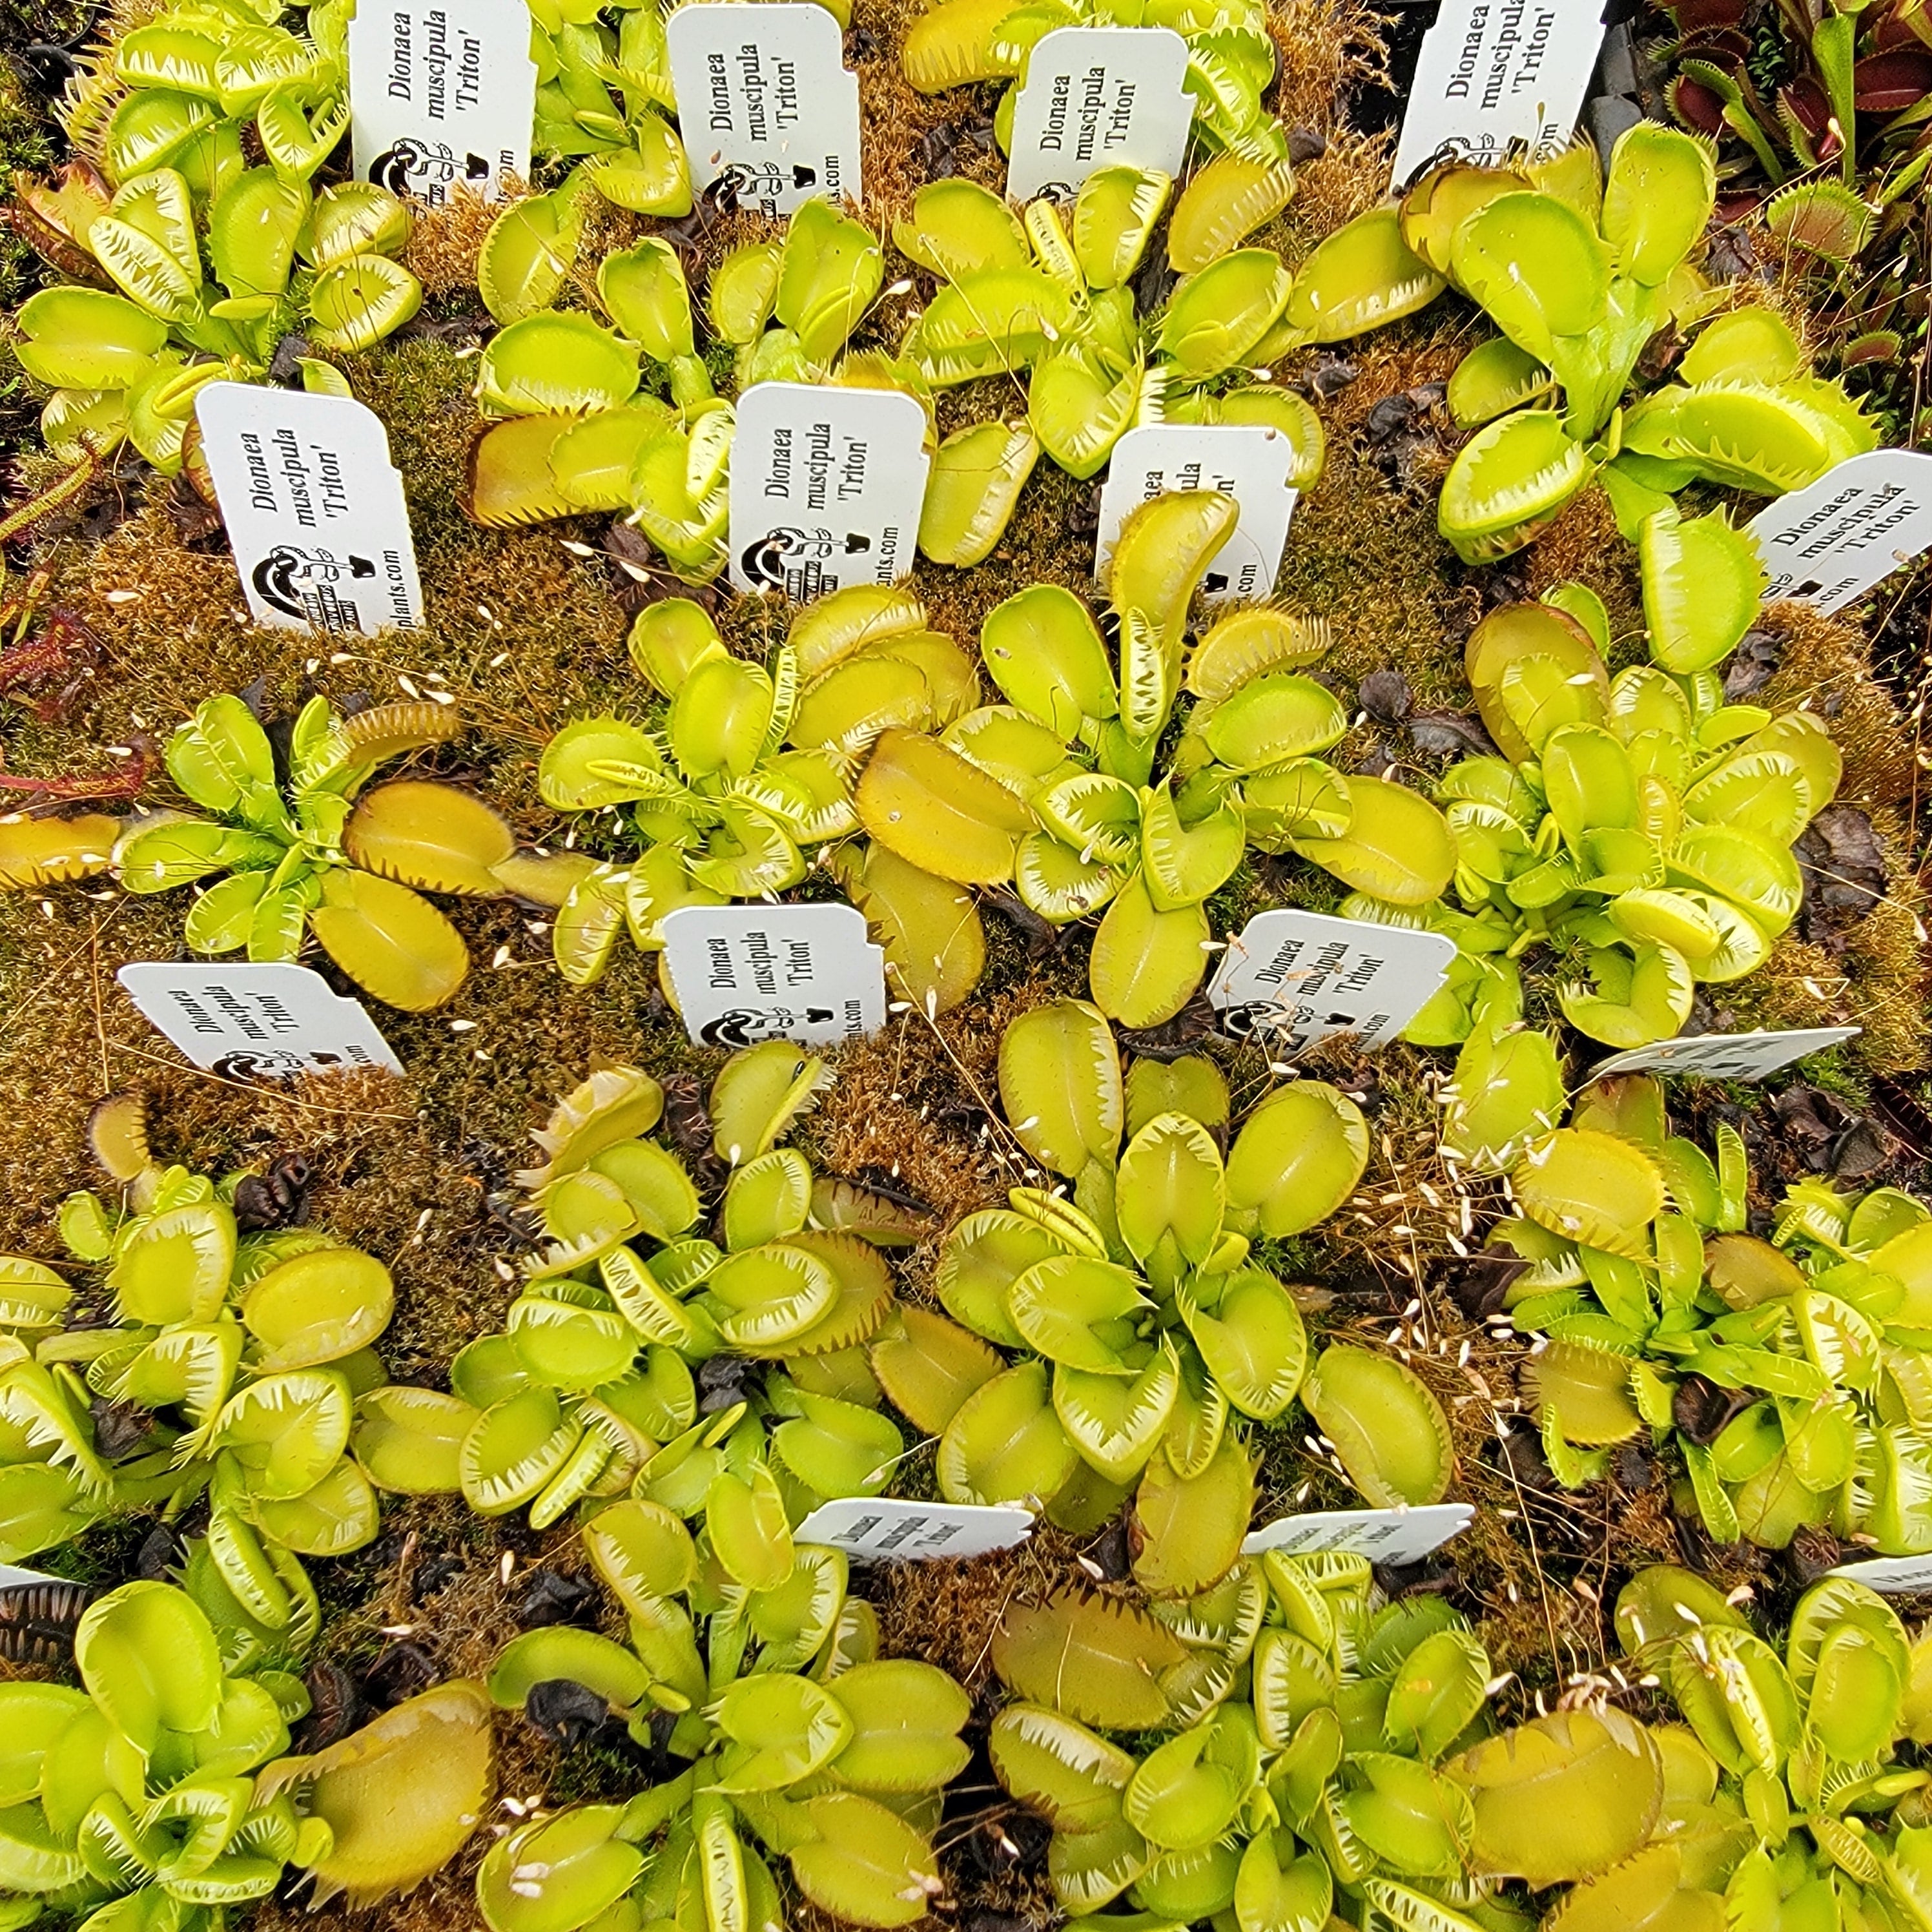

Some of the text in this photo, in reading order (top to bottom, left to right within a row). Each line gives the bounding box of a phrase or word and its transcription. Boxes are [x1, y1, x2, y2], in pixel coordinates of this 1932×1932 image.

[388, 12, 411, 101] Dionaea
[423, 10, 452, 121] muscipula
[455, 30, 480, 111] 'Triton'
[1445, 5, 1490, 99] Dionaea
[1511, 7, 1556, 94] 'Triton'
[707, 54, 733, 131] Dionaea
[736, 44, 768, 141] muscipula
[770, 57, 798, 129] 'Triton'
[1040, 75, 1071, 151] Dionaea
[1076, 67, 1105, 161] muscipula
[1104, 79, 1136, 149] 'Triton'
[241, 433, 278, 513] Dionaea
[270, 429, 316, 528] muscipula
[310, 445, 349, 519] 'Triton'
[765, 429, 792, 498] Dionaea
[804, 423, 836, 510] muscipula
[838, 436, 867, 501] 'Triton'
[1770, 488, 1864, 546] Dionaea
[1834, 500, 1922, 554] 'Triton'
[707, 938, 737, 990] Dionaea
[740, 931, 778, 995] muscipula
[781, 939, 814, 987] 'Triton'
[1255, 939, 1305, 985] Dionaea
[1332, 954, 1384, 994] 'Triton'
